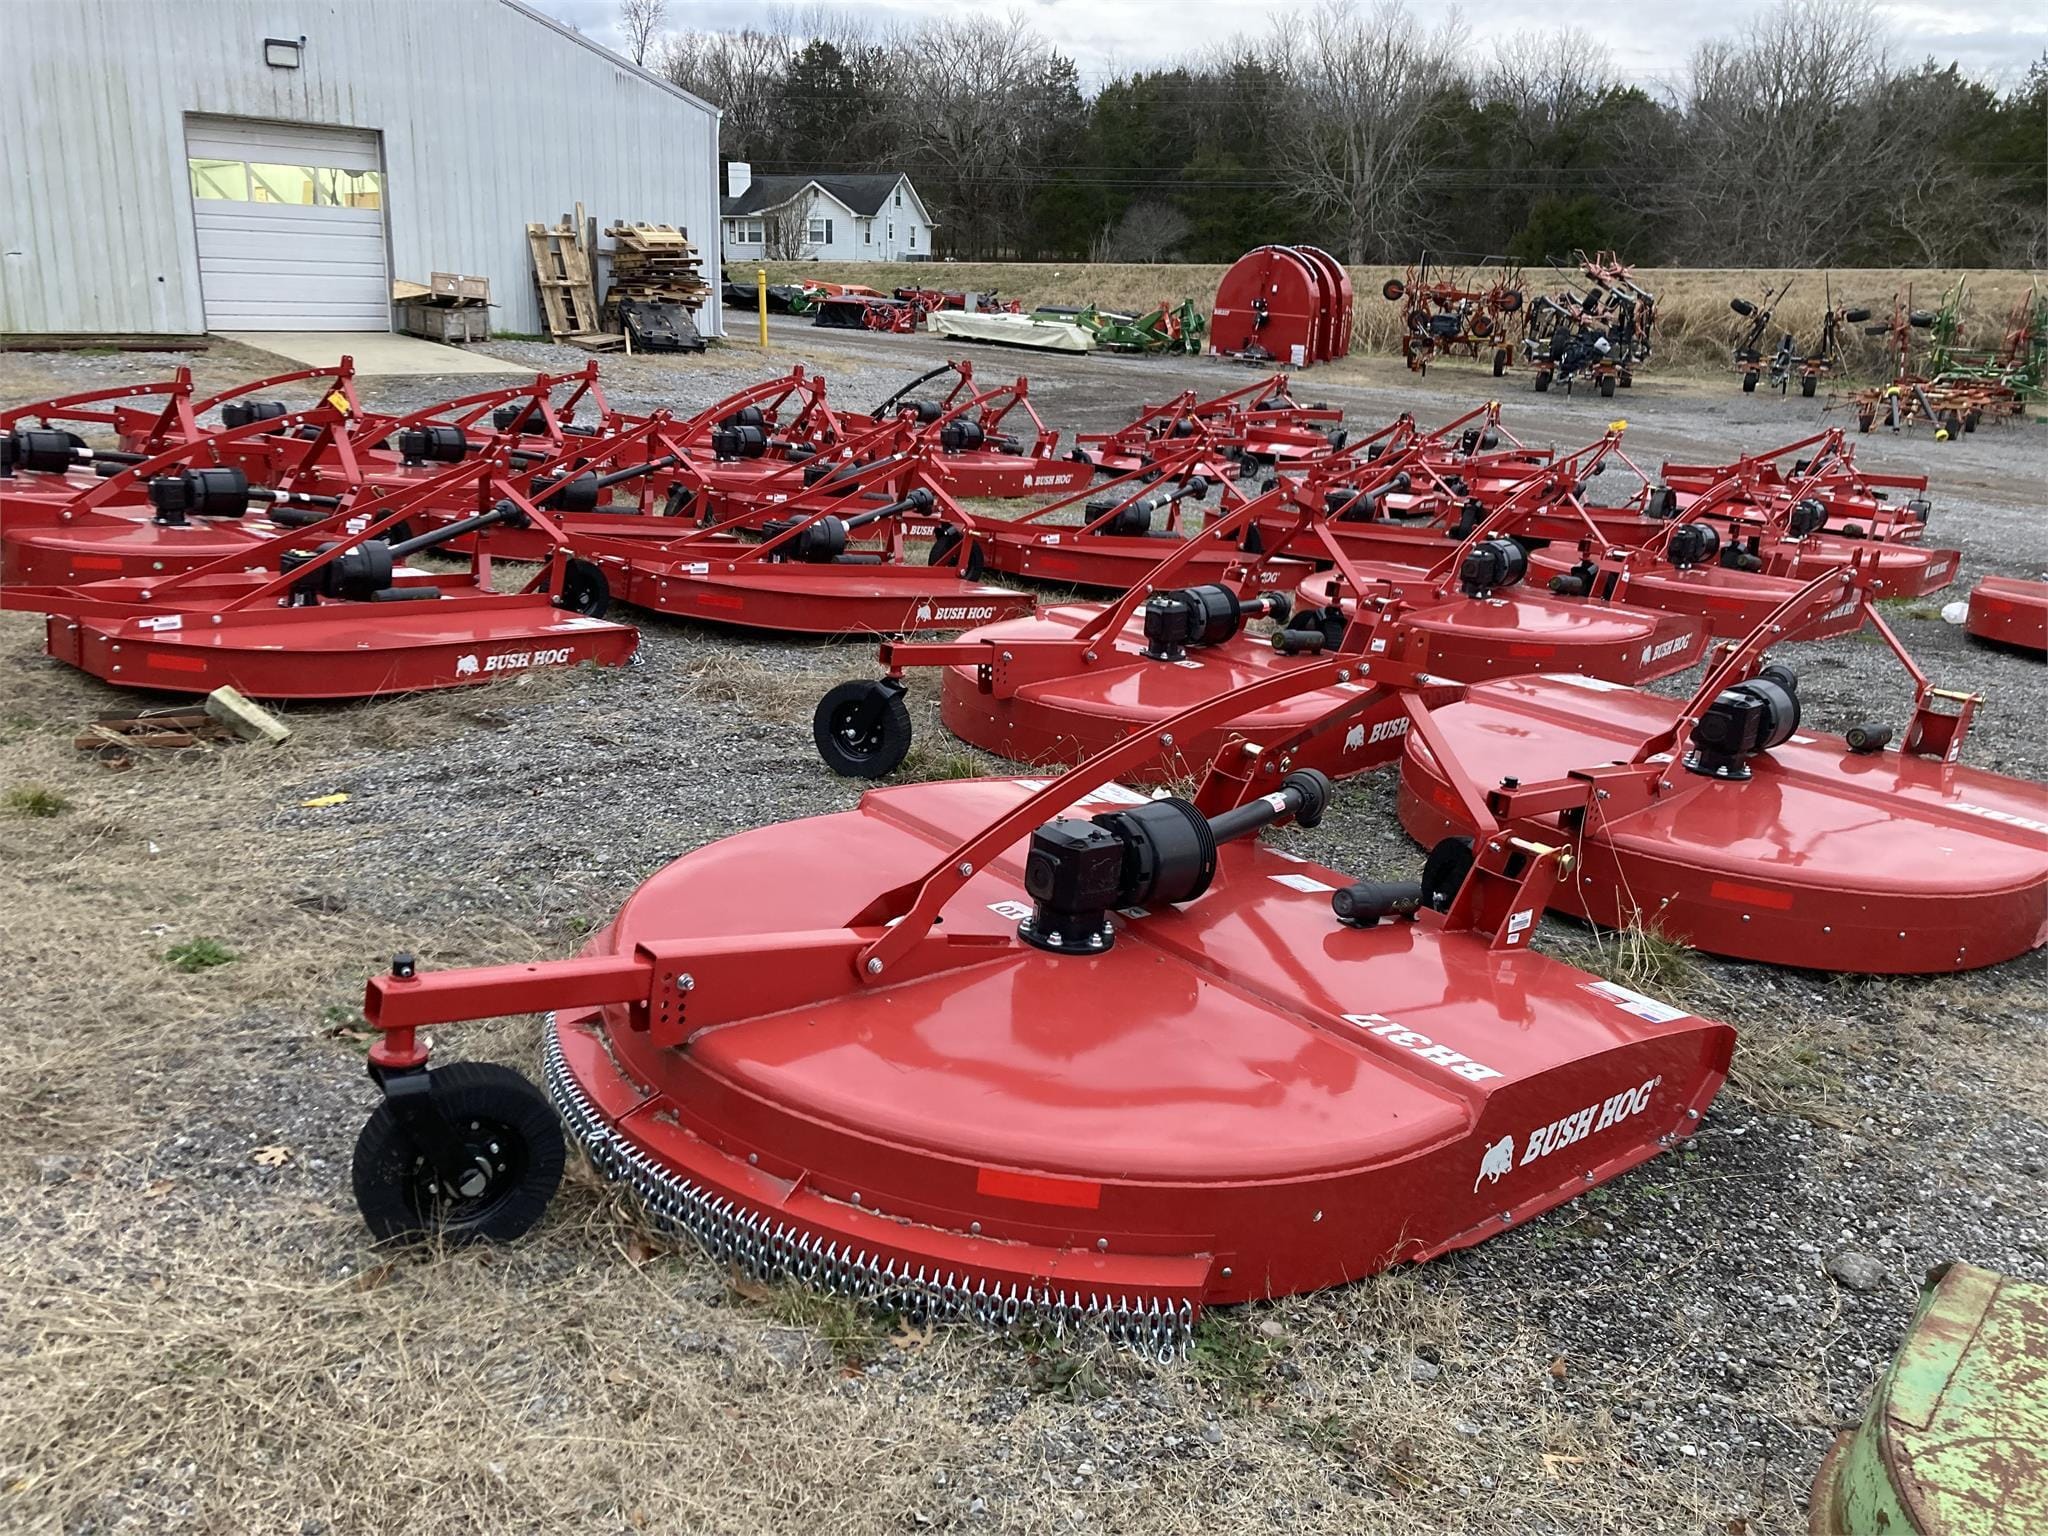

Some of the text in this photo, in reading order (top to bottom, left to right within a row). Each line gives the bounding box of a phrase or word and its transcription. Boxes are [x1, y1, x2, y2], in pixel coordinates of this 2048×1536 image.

[910, 525, 935, 536] BUSH
[935, 607, 993, 620] BUSH HOG
[484, 648, 570, 671] BUSH HOG
[1651, 639, 1675, 661] BUSH
[1367, 716, 1410, 745] BUSH
[1340, 1013, 1505, 1082] BH317
[1519, 1078, 1656, 1167] BUSH HOG
